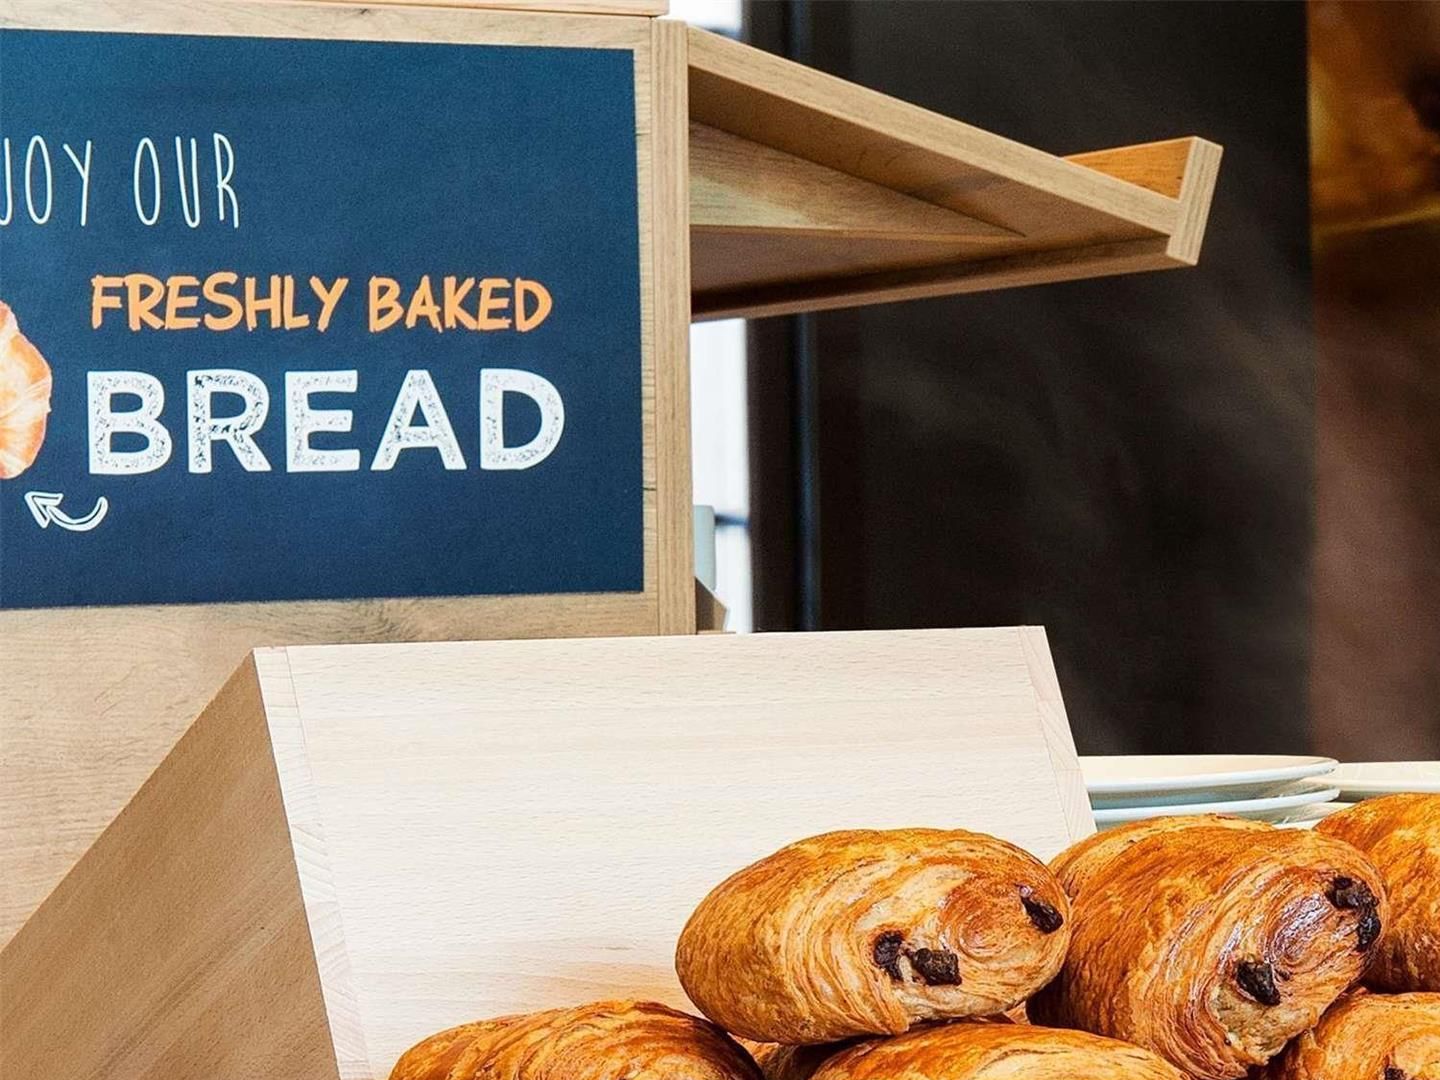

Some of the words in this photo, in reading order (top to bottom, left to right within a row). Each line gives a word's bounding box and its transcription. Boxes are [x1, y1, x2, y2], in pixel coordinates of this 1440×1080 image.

[133, 133, 240, 229] OUR
[90, 272, 349, 331] FRESHLY
[367, 275, 553, 332] BAKED
[86, 369, 565, 475] BREAD
